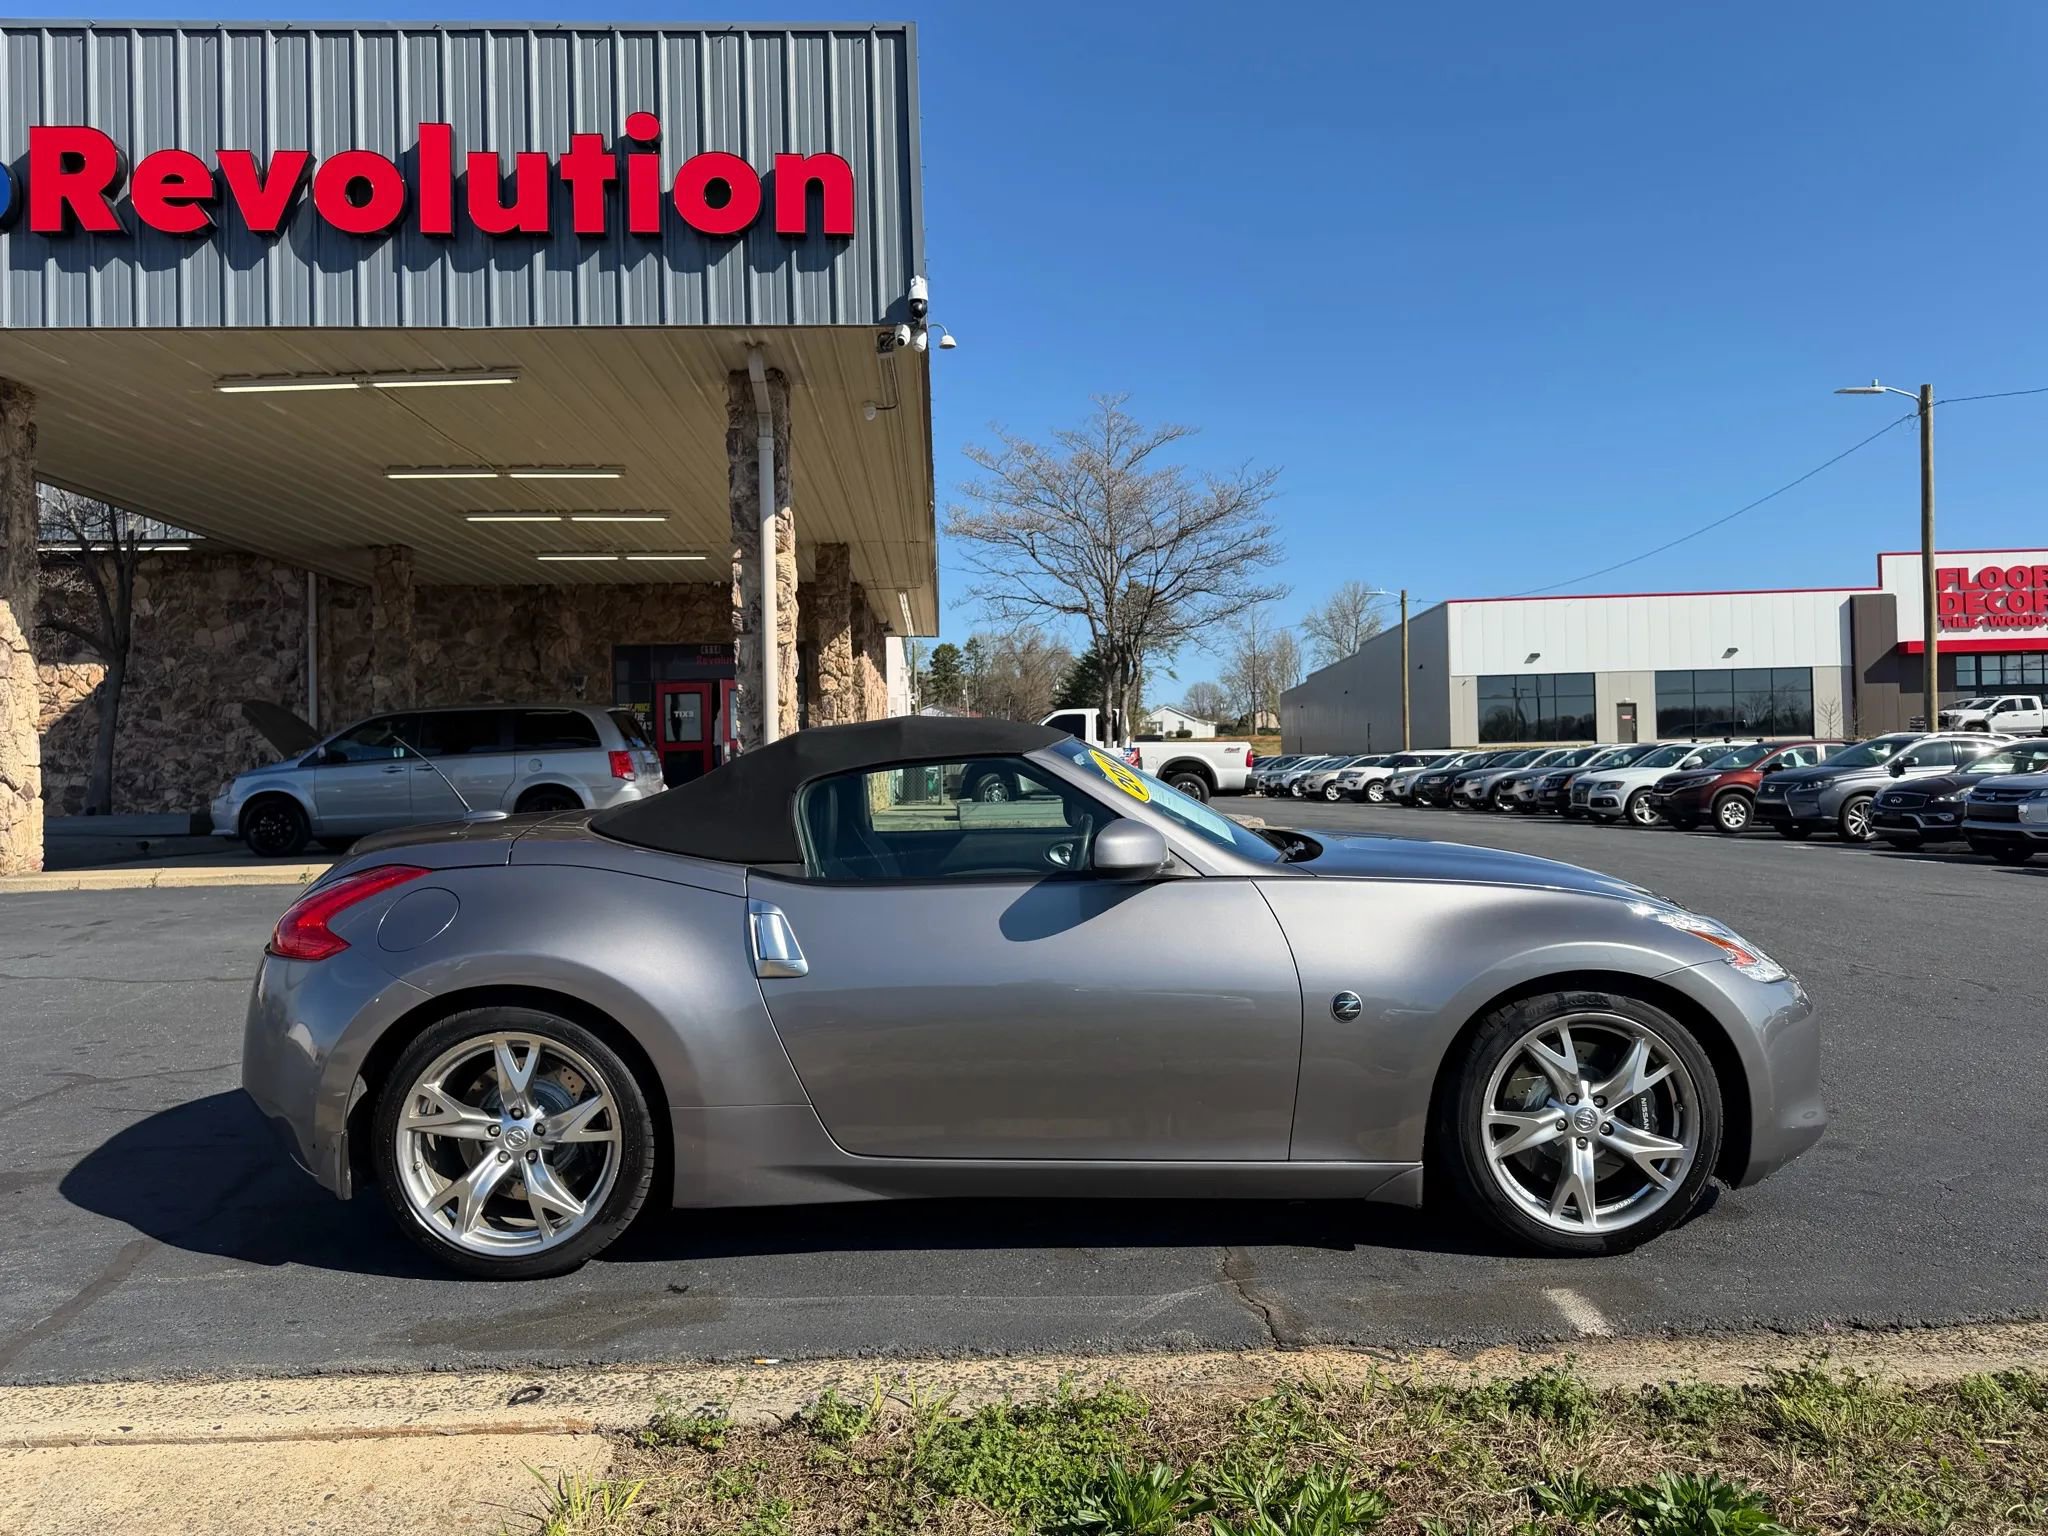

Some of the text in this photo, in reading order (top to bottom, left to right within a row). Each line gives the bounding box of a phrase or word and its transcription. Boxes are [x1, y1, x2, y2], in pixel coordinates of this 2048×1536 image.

[29, 111, 855, 237] Revolution
[1988, 615, 2041, 627] WOOD
[1640, 1097, 1650, 1130] NISSAN
